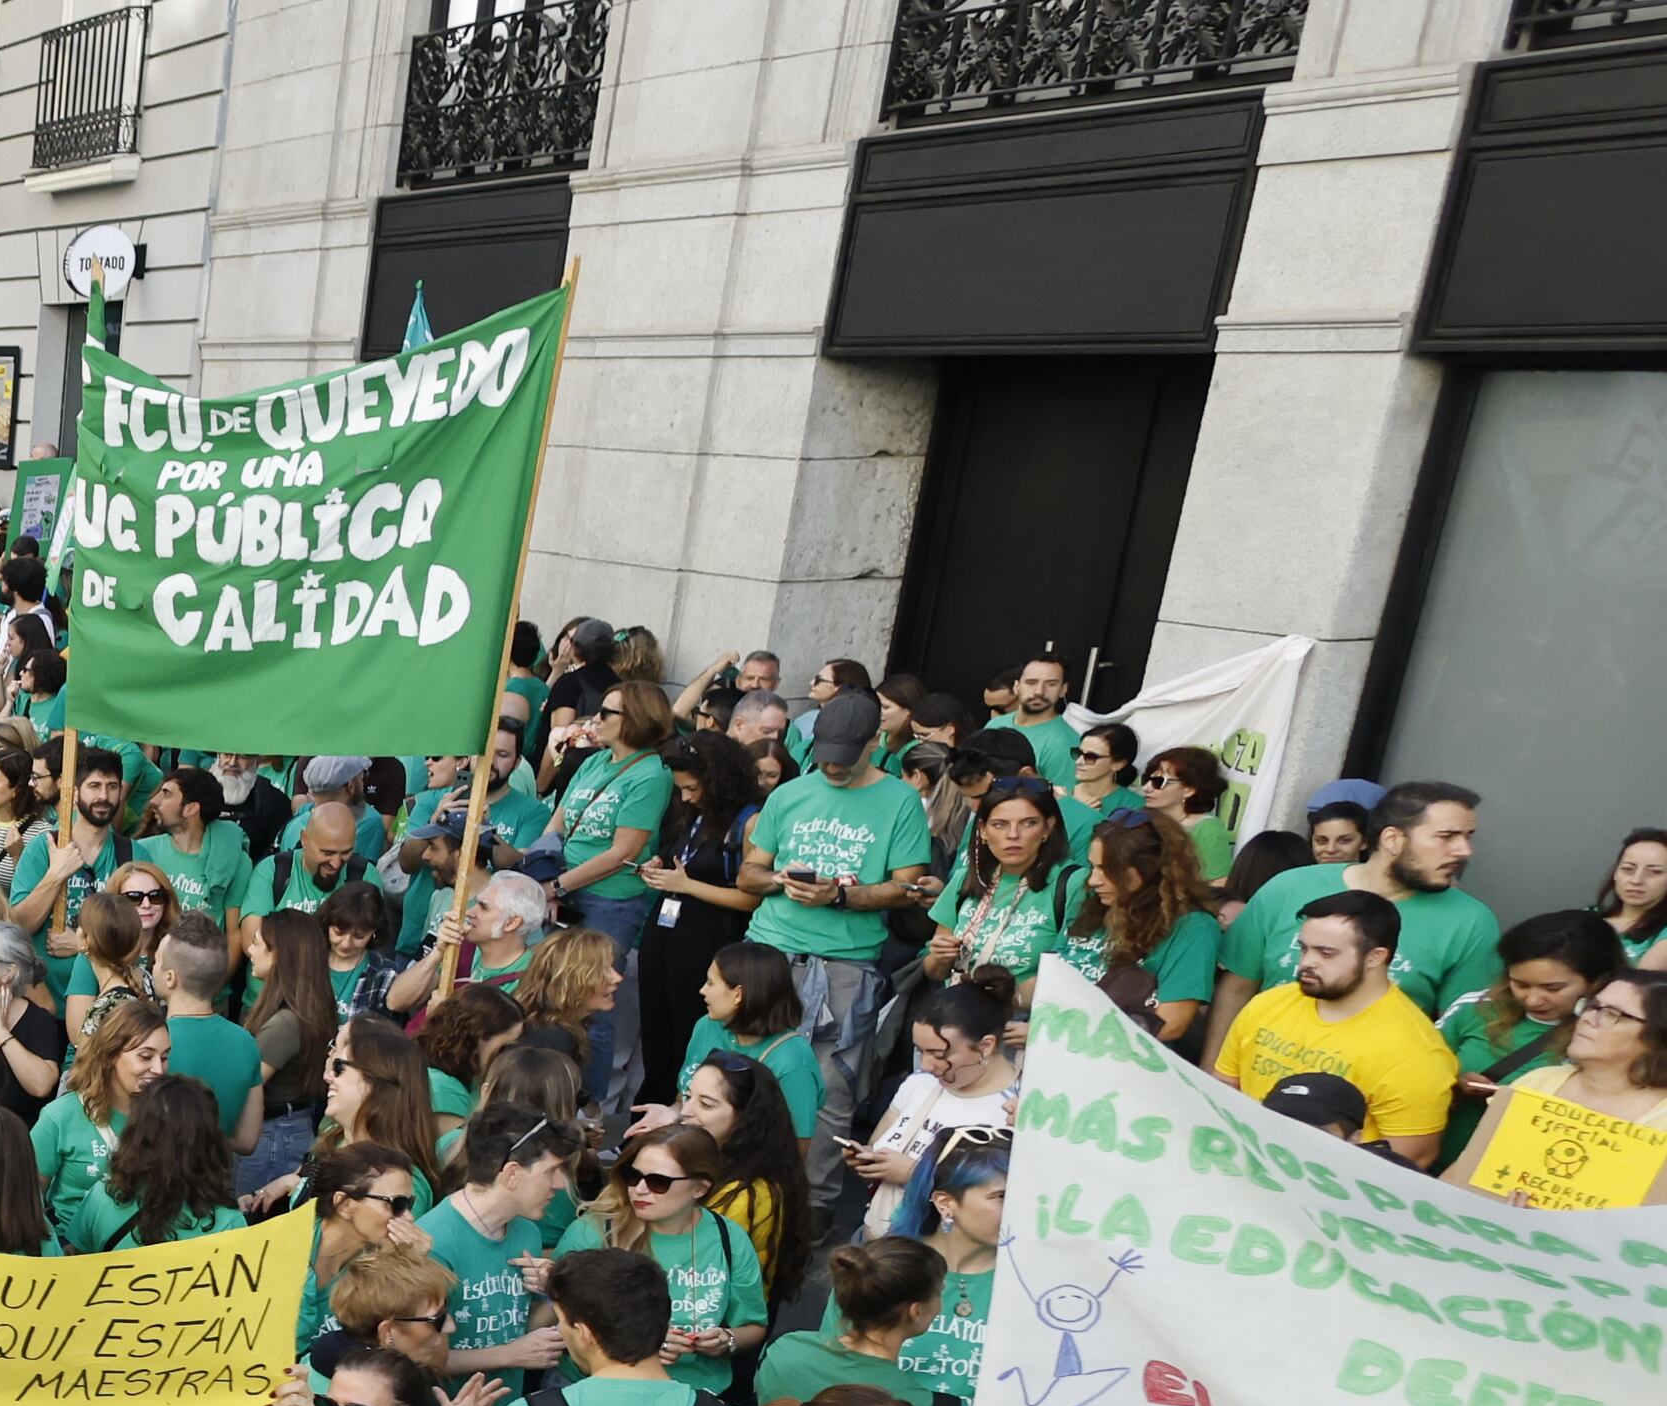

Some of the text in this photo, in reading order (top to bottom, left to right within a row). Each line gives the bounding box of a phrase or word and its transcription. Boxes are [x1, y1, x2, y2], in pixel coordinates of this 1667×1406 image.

[79, 256, 125, 272] TOTADO
[210, 327, 532, 451] DE QUEVEDO
[156, 451, 325, 491] POR UNA
[154, 477, 444, 568] PÚBLICA
[81, 563, 472, 655] DE CALIDAD
[1029, 1001, 1170, 1074] MÁS
[1254, 1026, 1353, 1077] EDUCACIÓN
[1014, 1092, 1169, 1162] MÁS
[1530, 1114, 1623, 1153] ESPECIAL
[83, 1239, 273, 1309] ESTÁN
[1168, 1213, 1665, 1376] EDUCACIÓN
[93, 1298, 273, 1359] ESTÁN
[14, 1363, 272, 1402] MAESTRAS
